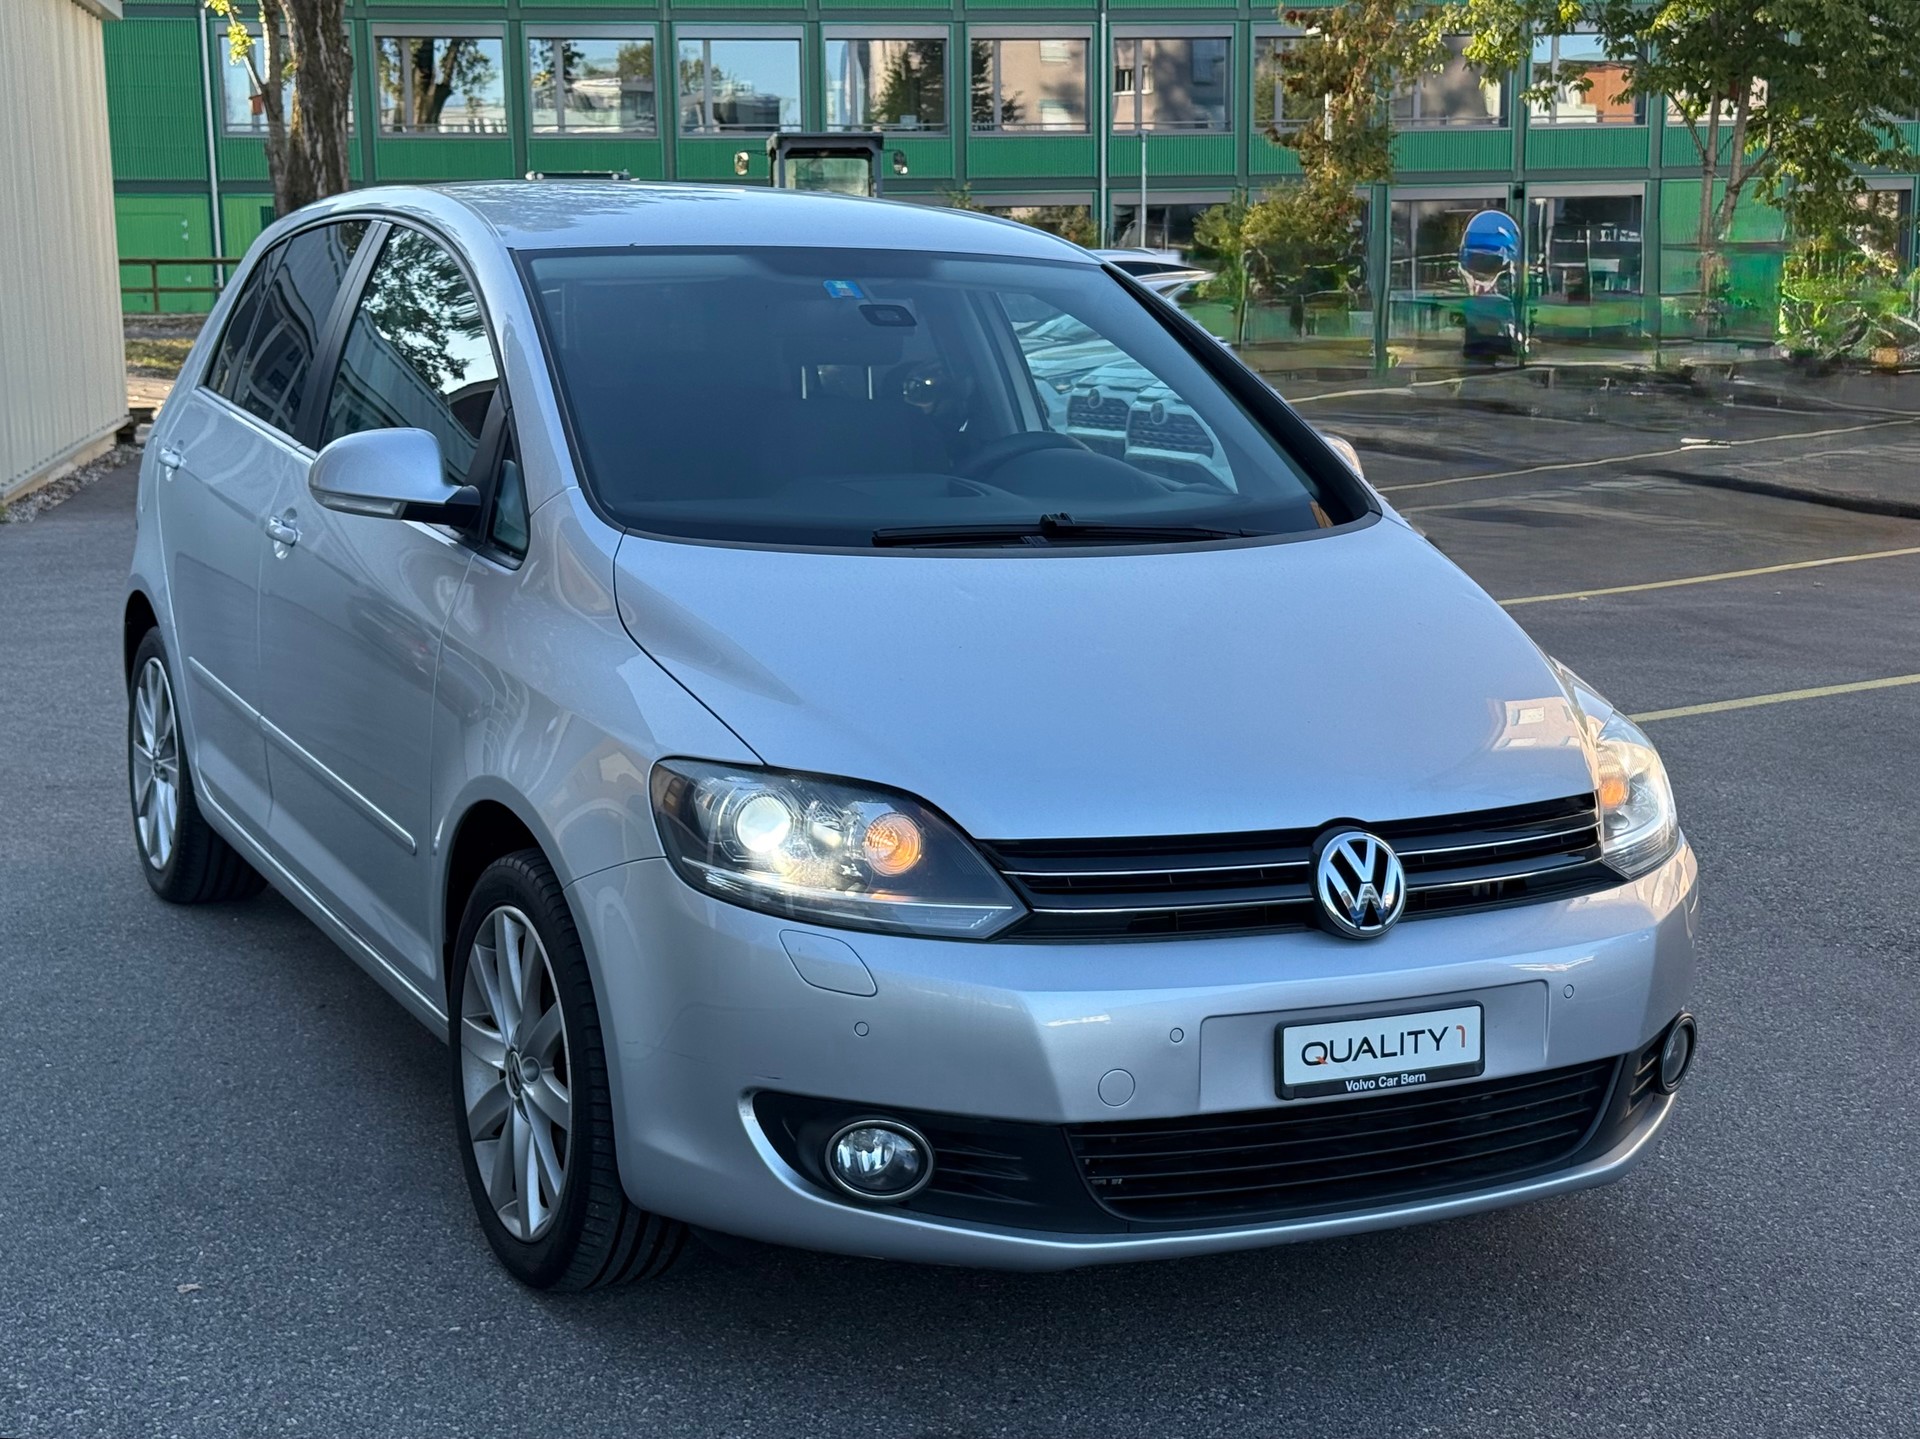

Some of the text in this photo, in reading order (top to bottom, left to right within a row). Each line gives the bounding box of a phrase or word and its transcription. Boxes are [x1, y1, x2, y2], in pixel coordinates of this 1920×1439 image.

[1320, 832, 1404, 936] VW
[1301, 1026, 1449, 1066] QUALITY
[1345, 1073, 1426, 1092] Volvo Car Bern
